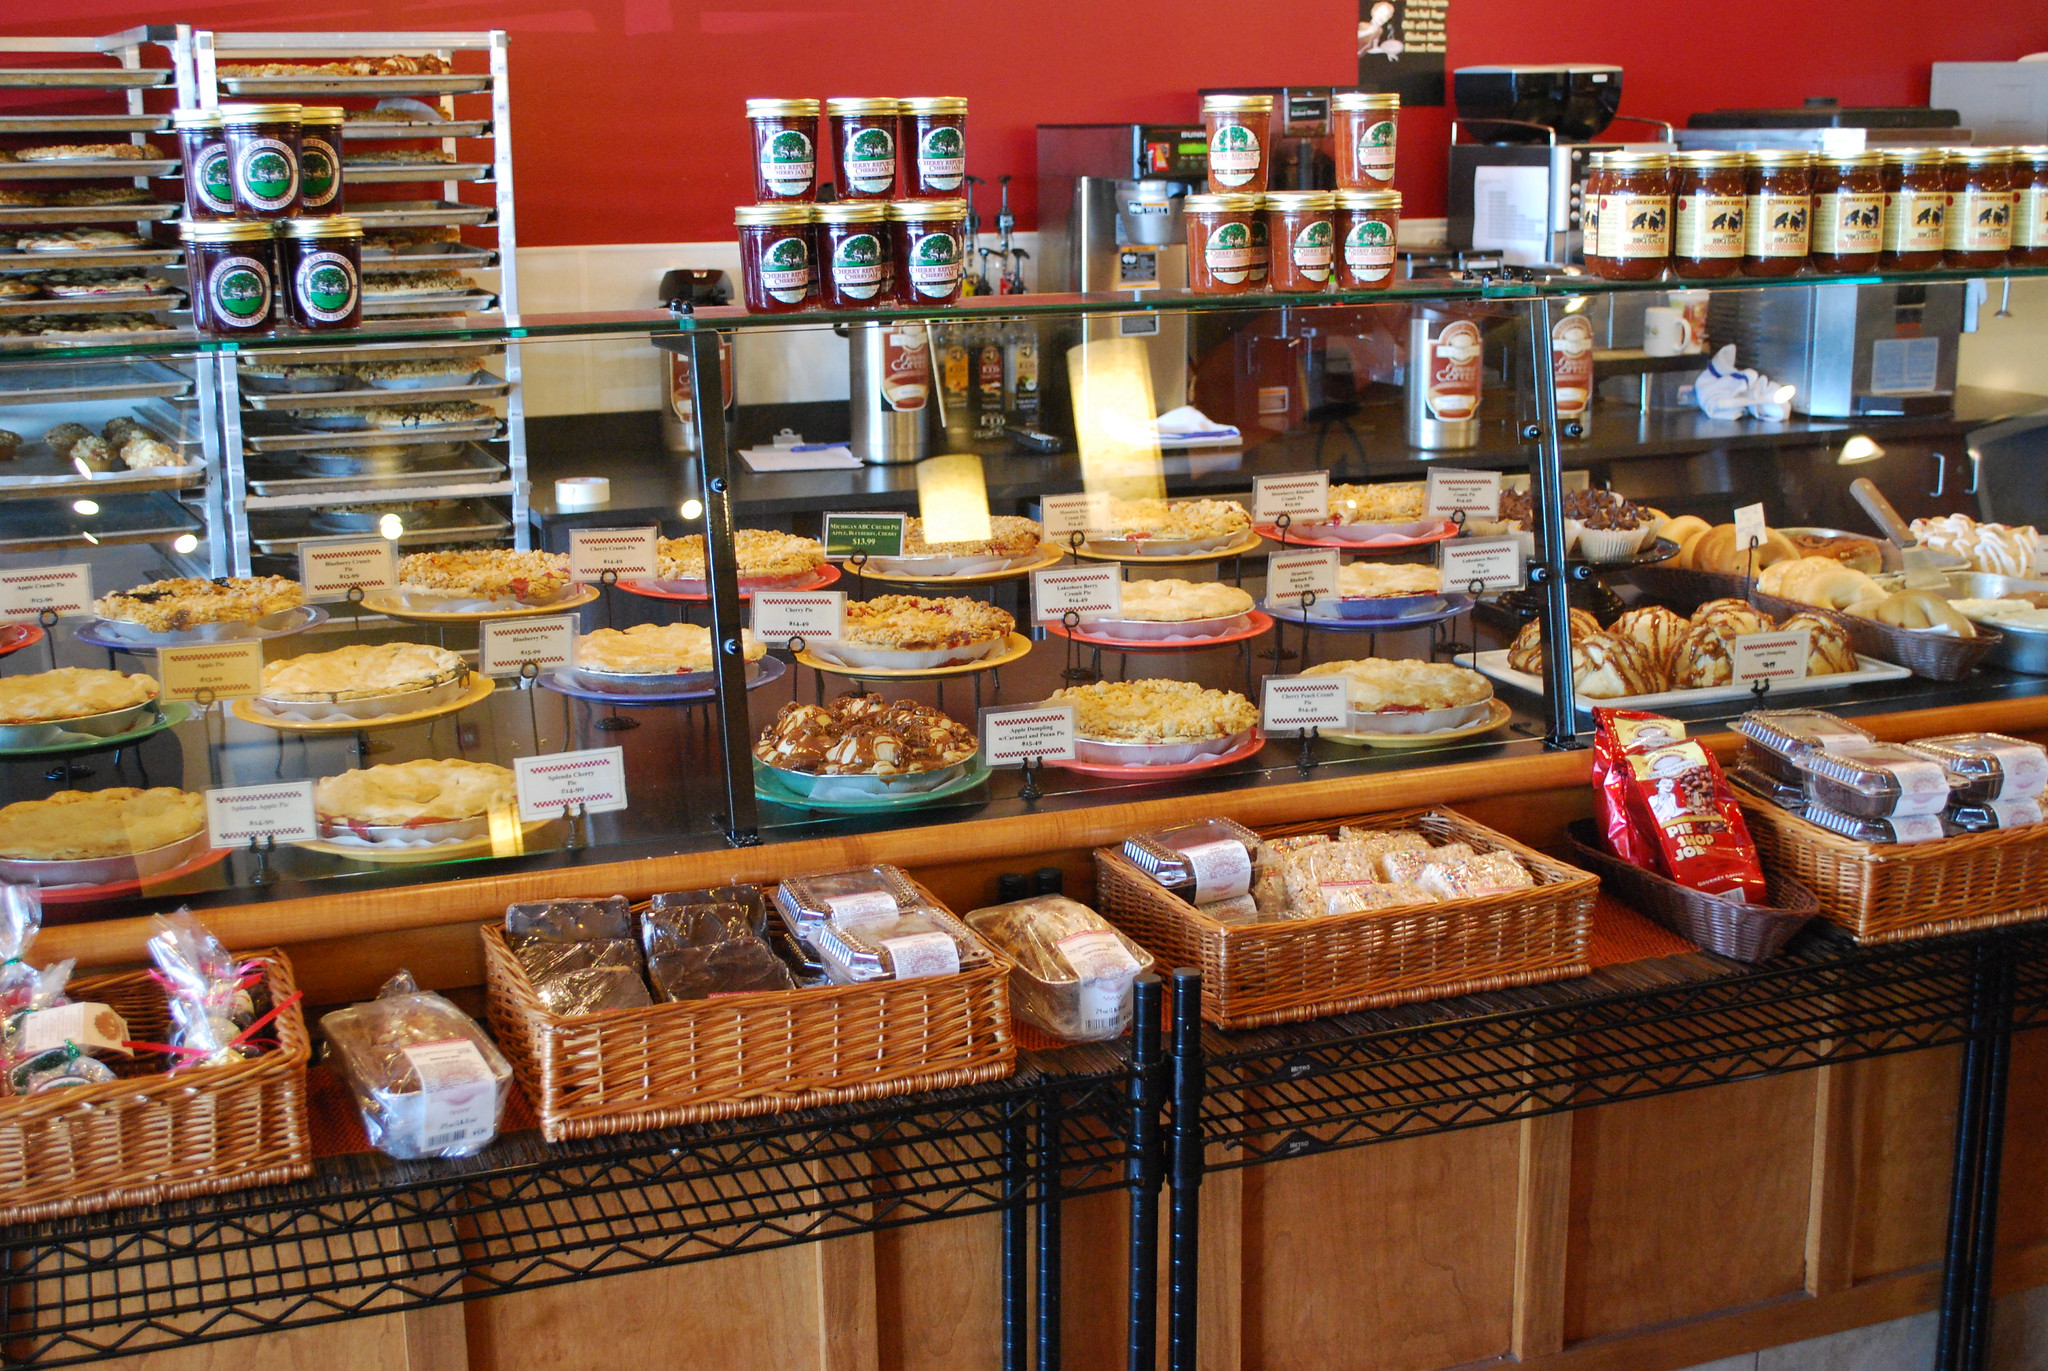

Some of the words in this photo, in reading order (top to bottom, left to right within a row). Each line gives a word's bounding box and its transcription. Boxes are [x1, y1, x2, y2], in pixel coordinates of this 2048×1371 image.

[212, 259, 234, 284] CHERRY
[235, 257, 267, 277] REPUBLIC
[763, 270, 790, 280] CHERRY
[833, 268, 861, 276] CHERRY
[251, 310, 267, 325] JELLY
[852, 537, 876, 545] $13.99
[1027, 724, 1054, 732] Dumpling
[1661, 761, 1695, 775] COMPANY
[547, 773, 572, 782] Splenda
[573, 770, 594, 778] Cherry
[1665, 822, 1694, 839] PIE
[1676, 834, 1715, 848] SHOP
[1674, 845, 1707, 862] JOE
[1697, 875, 1724, 887] GOURMET
[1725, 871, 1745, 879] COFFEE
